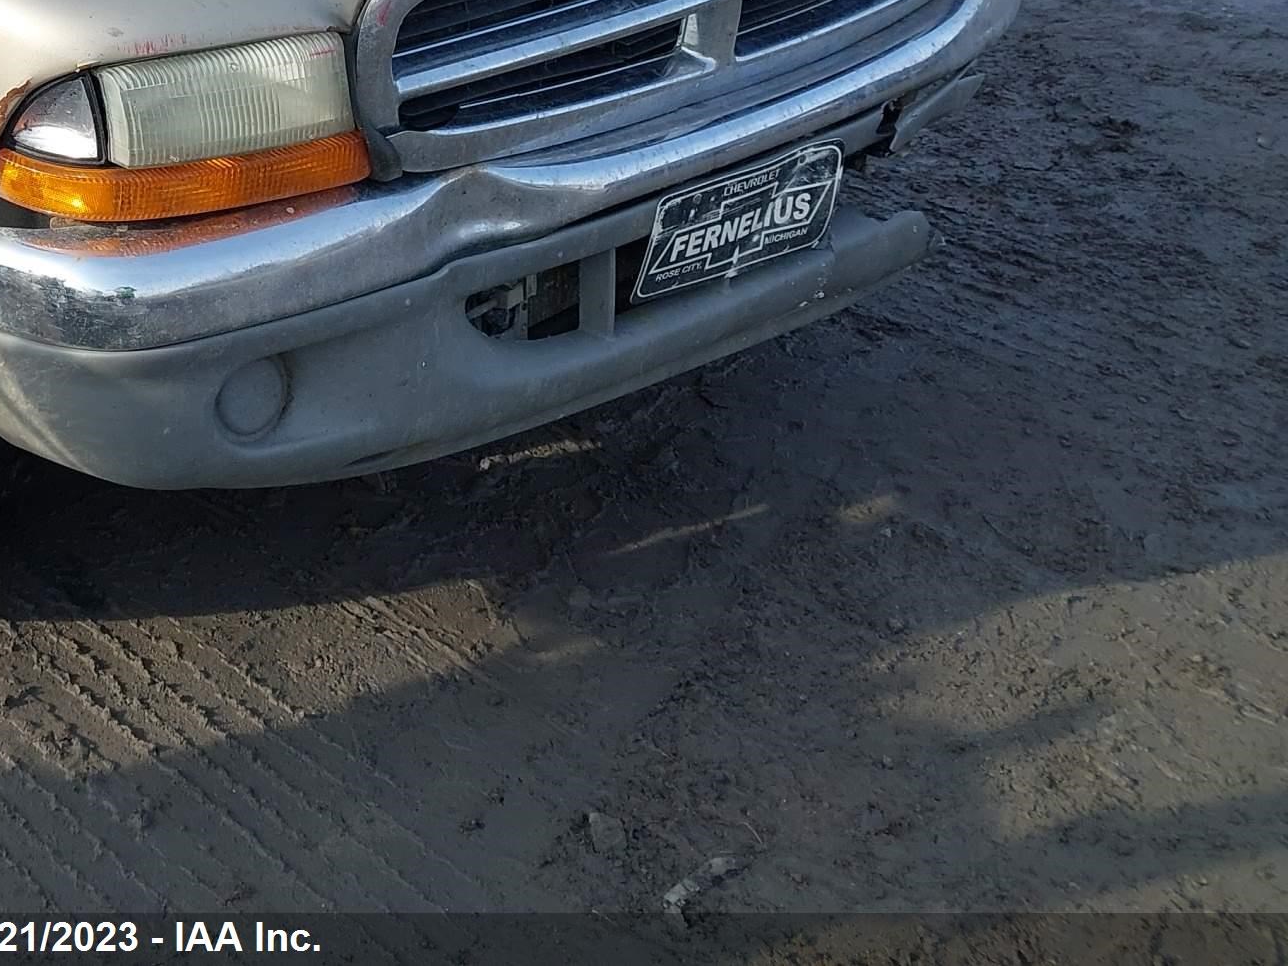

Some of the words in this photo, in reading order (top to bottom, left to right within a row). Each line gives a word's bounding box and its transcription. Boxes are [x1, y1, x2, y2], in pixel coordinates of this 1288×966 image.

[723, 168, 782, 197] CHEVROLET
[669, 192, 812, 263] FERNELIUS
[764, 227, 809, 245] MICHIGAN
[655, 268, 681, 282] ROSE
